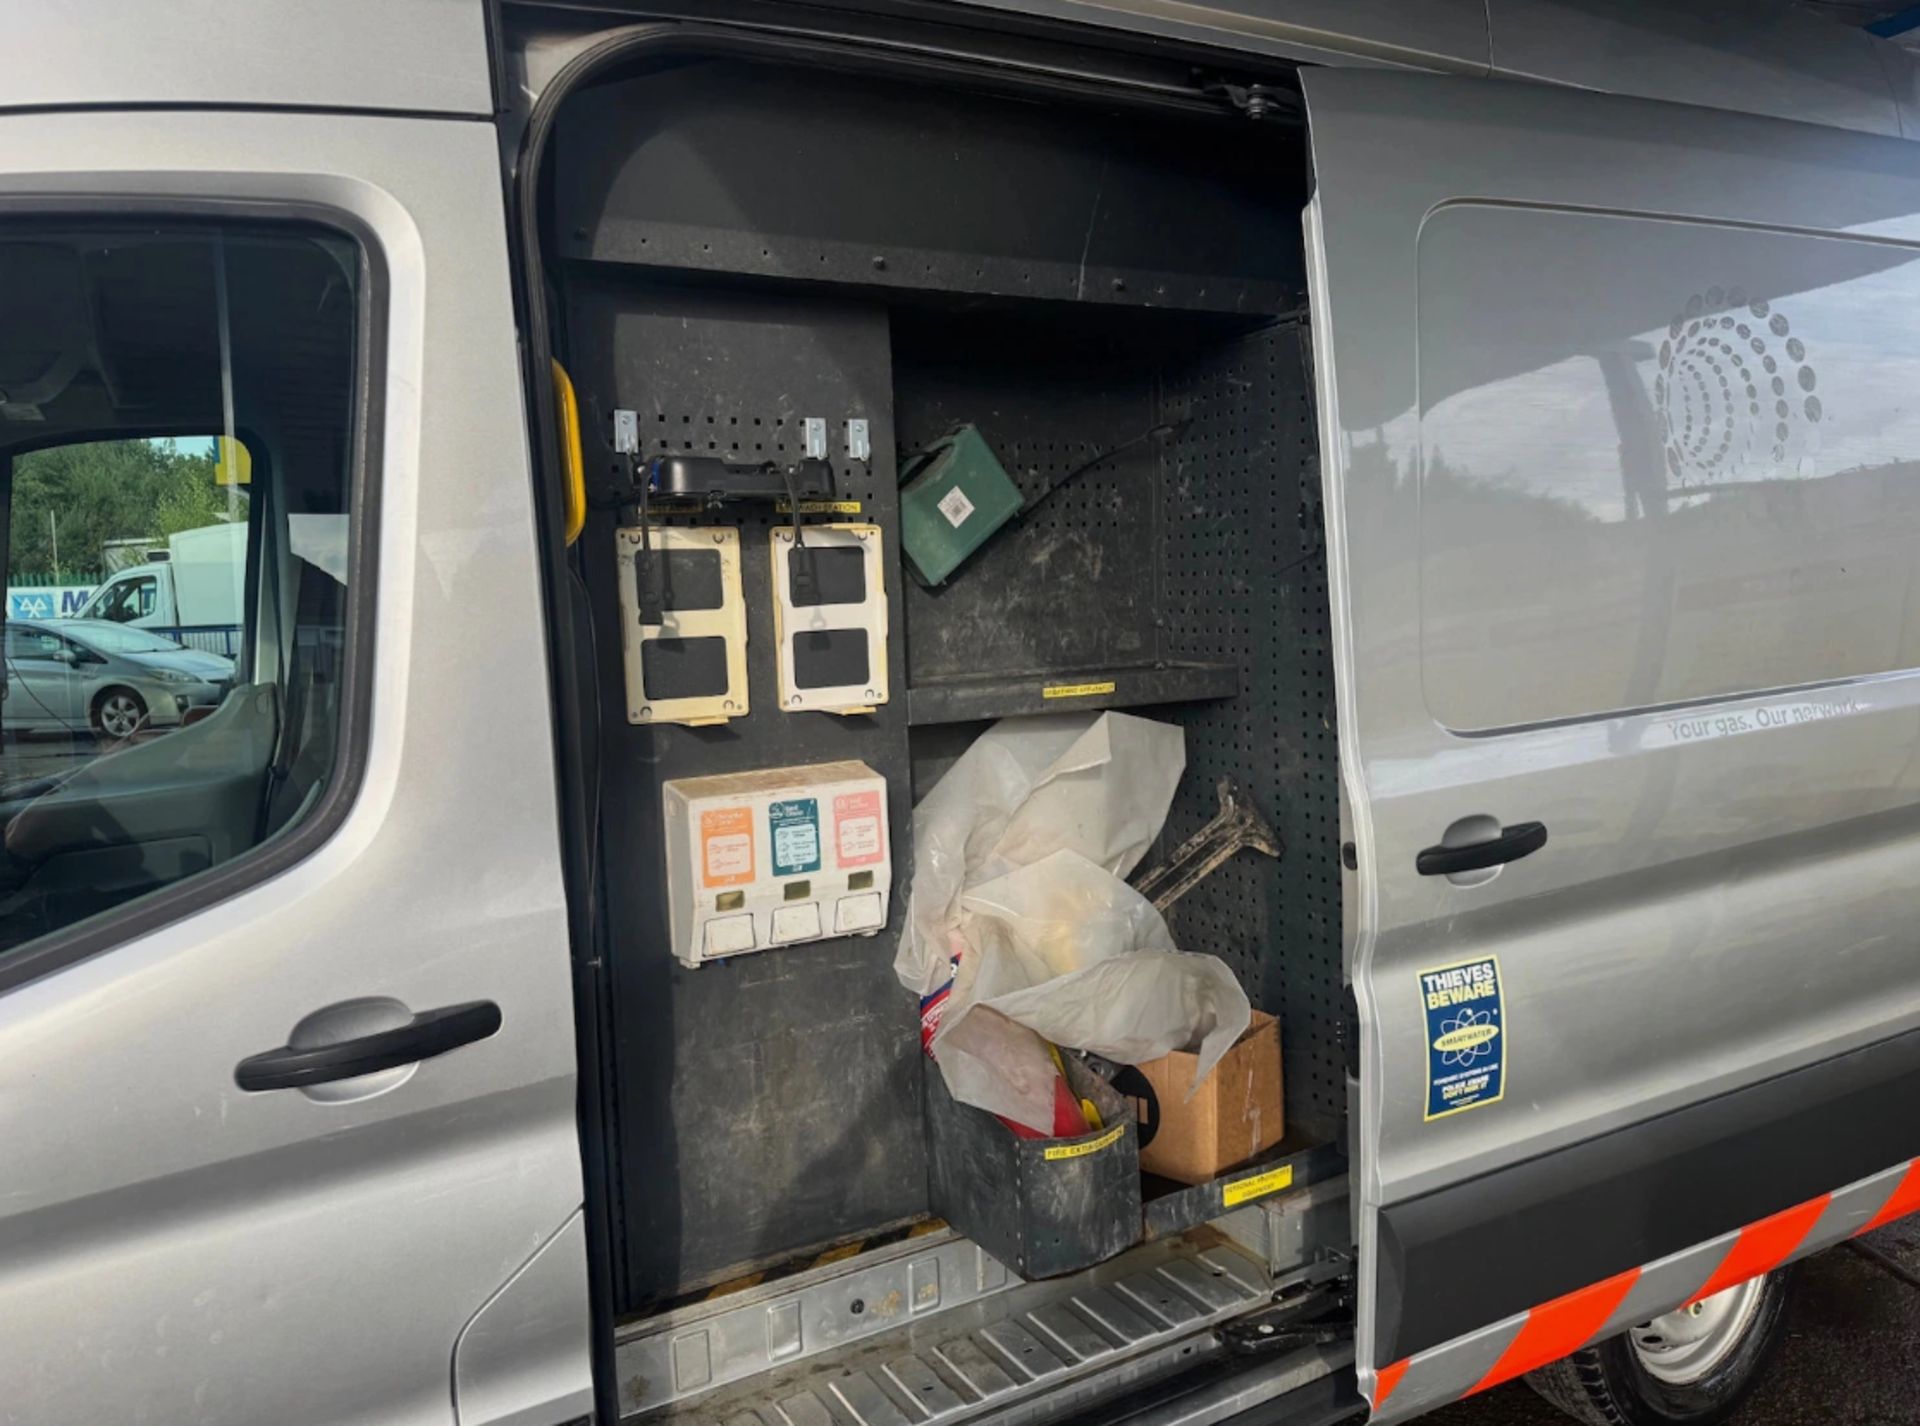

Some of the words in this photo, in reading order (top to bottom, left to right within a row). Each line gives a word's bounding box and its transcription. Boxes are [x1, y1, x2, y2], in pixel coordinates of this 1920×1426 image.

[1667, 722, 1711, 741] Your
[1715, 714, 1754, 736] gas.
[1756, 707, 1788, 727] Our
[1424, 963, 1494, 992] THIEVES
[1427, 979, 1496, 1010] BEWARE
